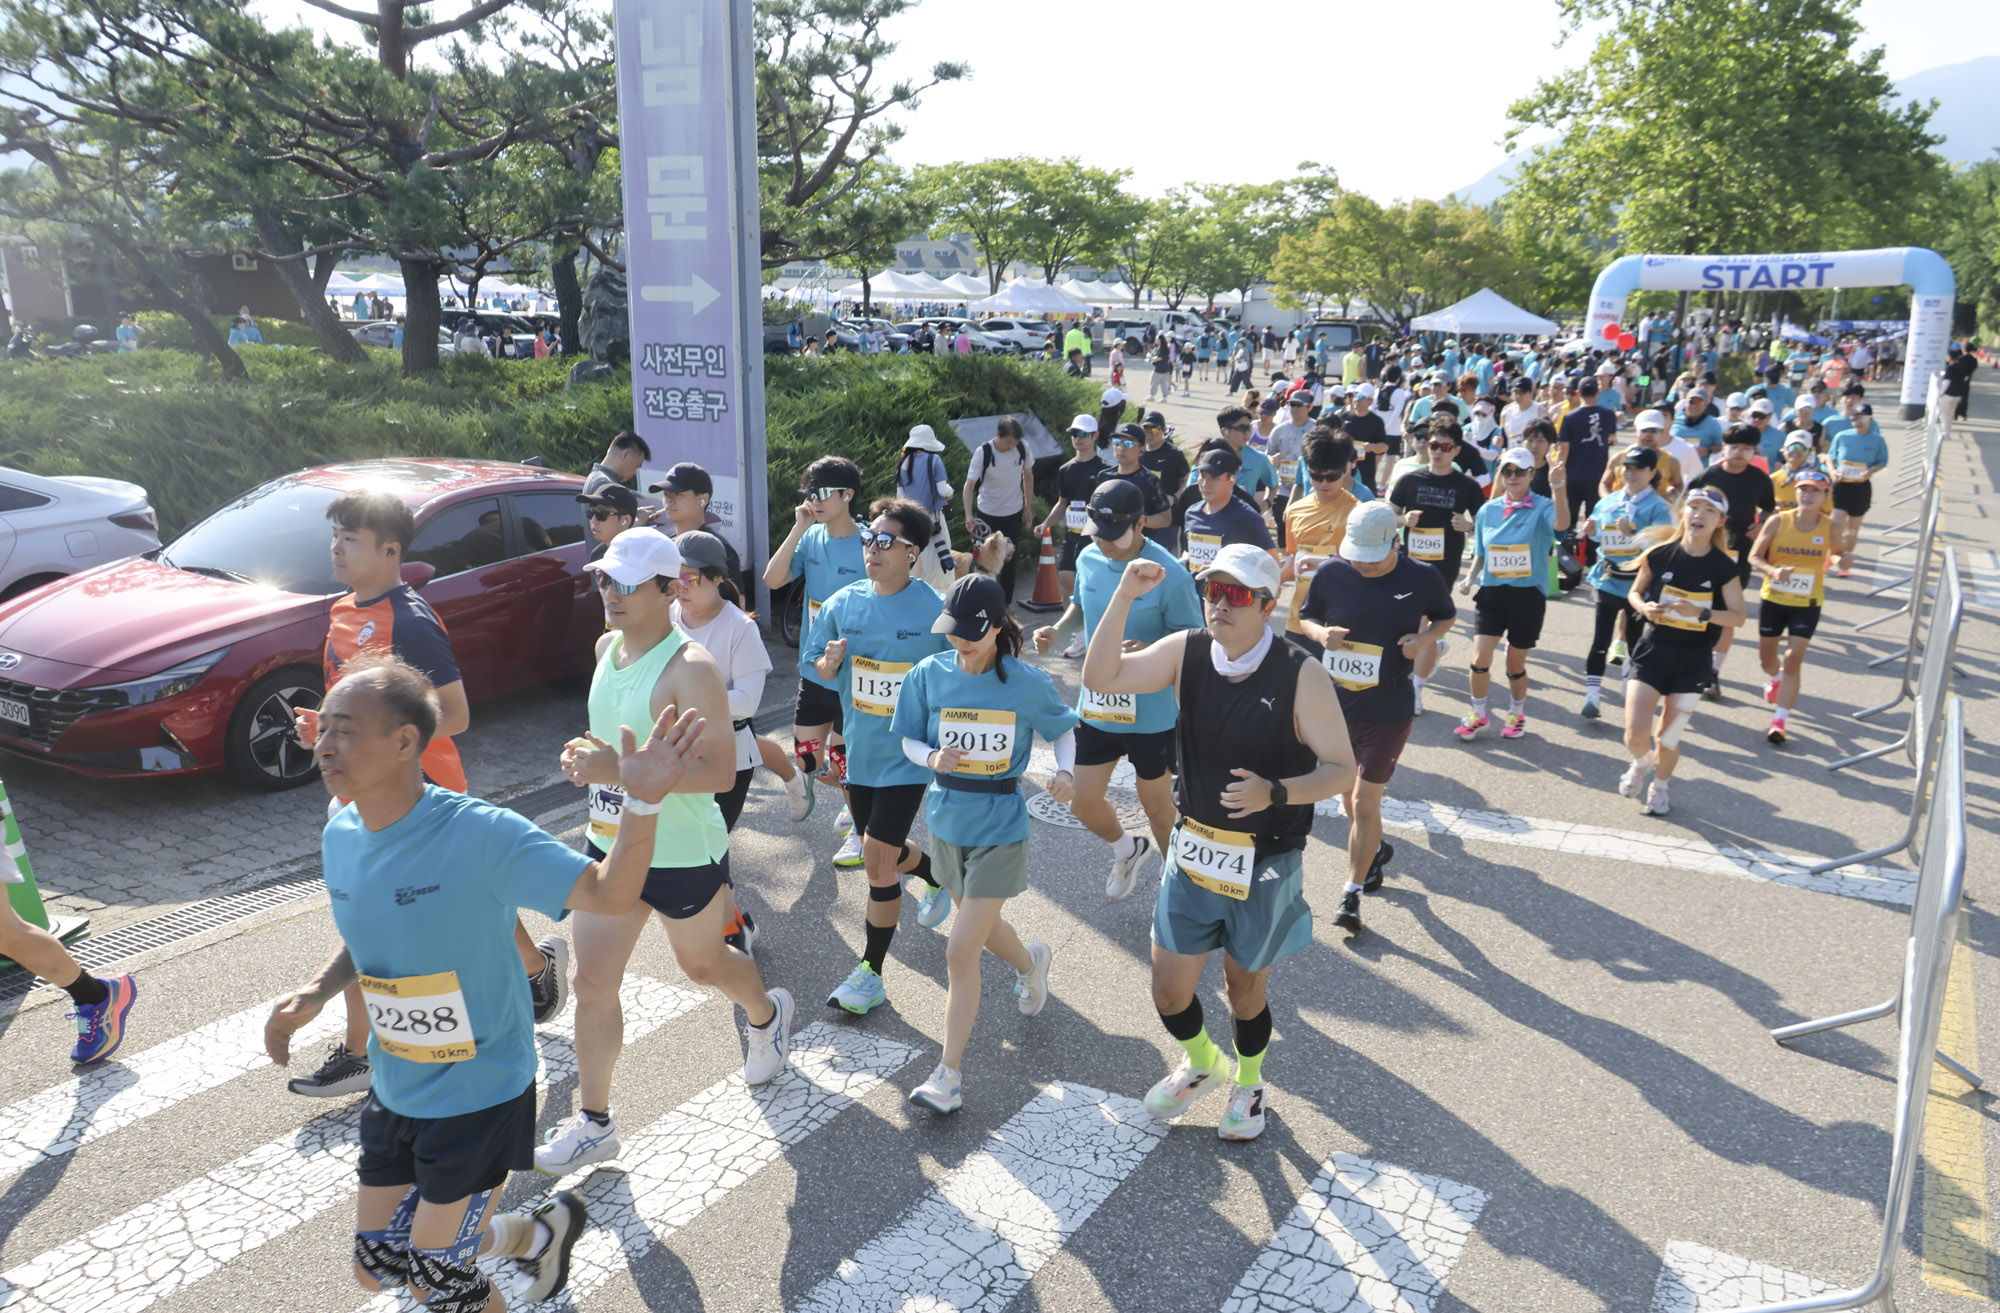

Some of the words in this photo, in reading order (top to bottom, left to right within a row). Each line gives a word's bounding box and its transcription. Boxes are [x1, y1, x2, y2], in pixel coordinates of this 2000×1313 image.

[640, 14, 707, 240] 남문
[1702, 263, 1835, 288] START
[641, 344, 726, 377] 사전무인
[644, 387, 728, 422] 전용출구
[1190, 546, 1218, 560] 2282
[1411, 538, 1441, 549] 1296
[1493, 555, 1528, 567] 1302
[1329, 656, 1374, 678] 1083
[1088, 690, 1131, 708] 1208
[1, 700, 27, 722] 3090
[944, 731, 1008, 752] 2013
[985, 764, 995, 772] 10
[995, 762, 1007, 770] km
[1182, 840, 1247, 875] 2074
[1219, 883, 1230, 893] 10
[1230, 884, 1245, 896] km
[368, 1003, 458, 1035] 2288
[430, 1050, 445, 1060] 10
[447, 1048, 470, 1058] km
